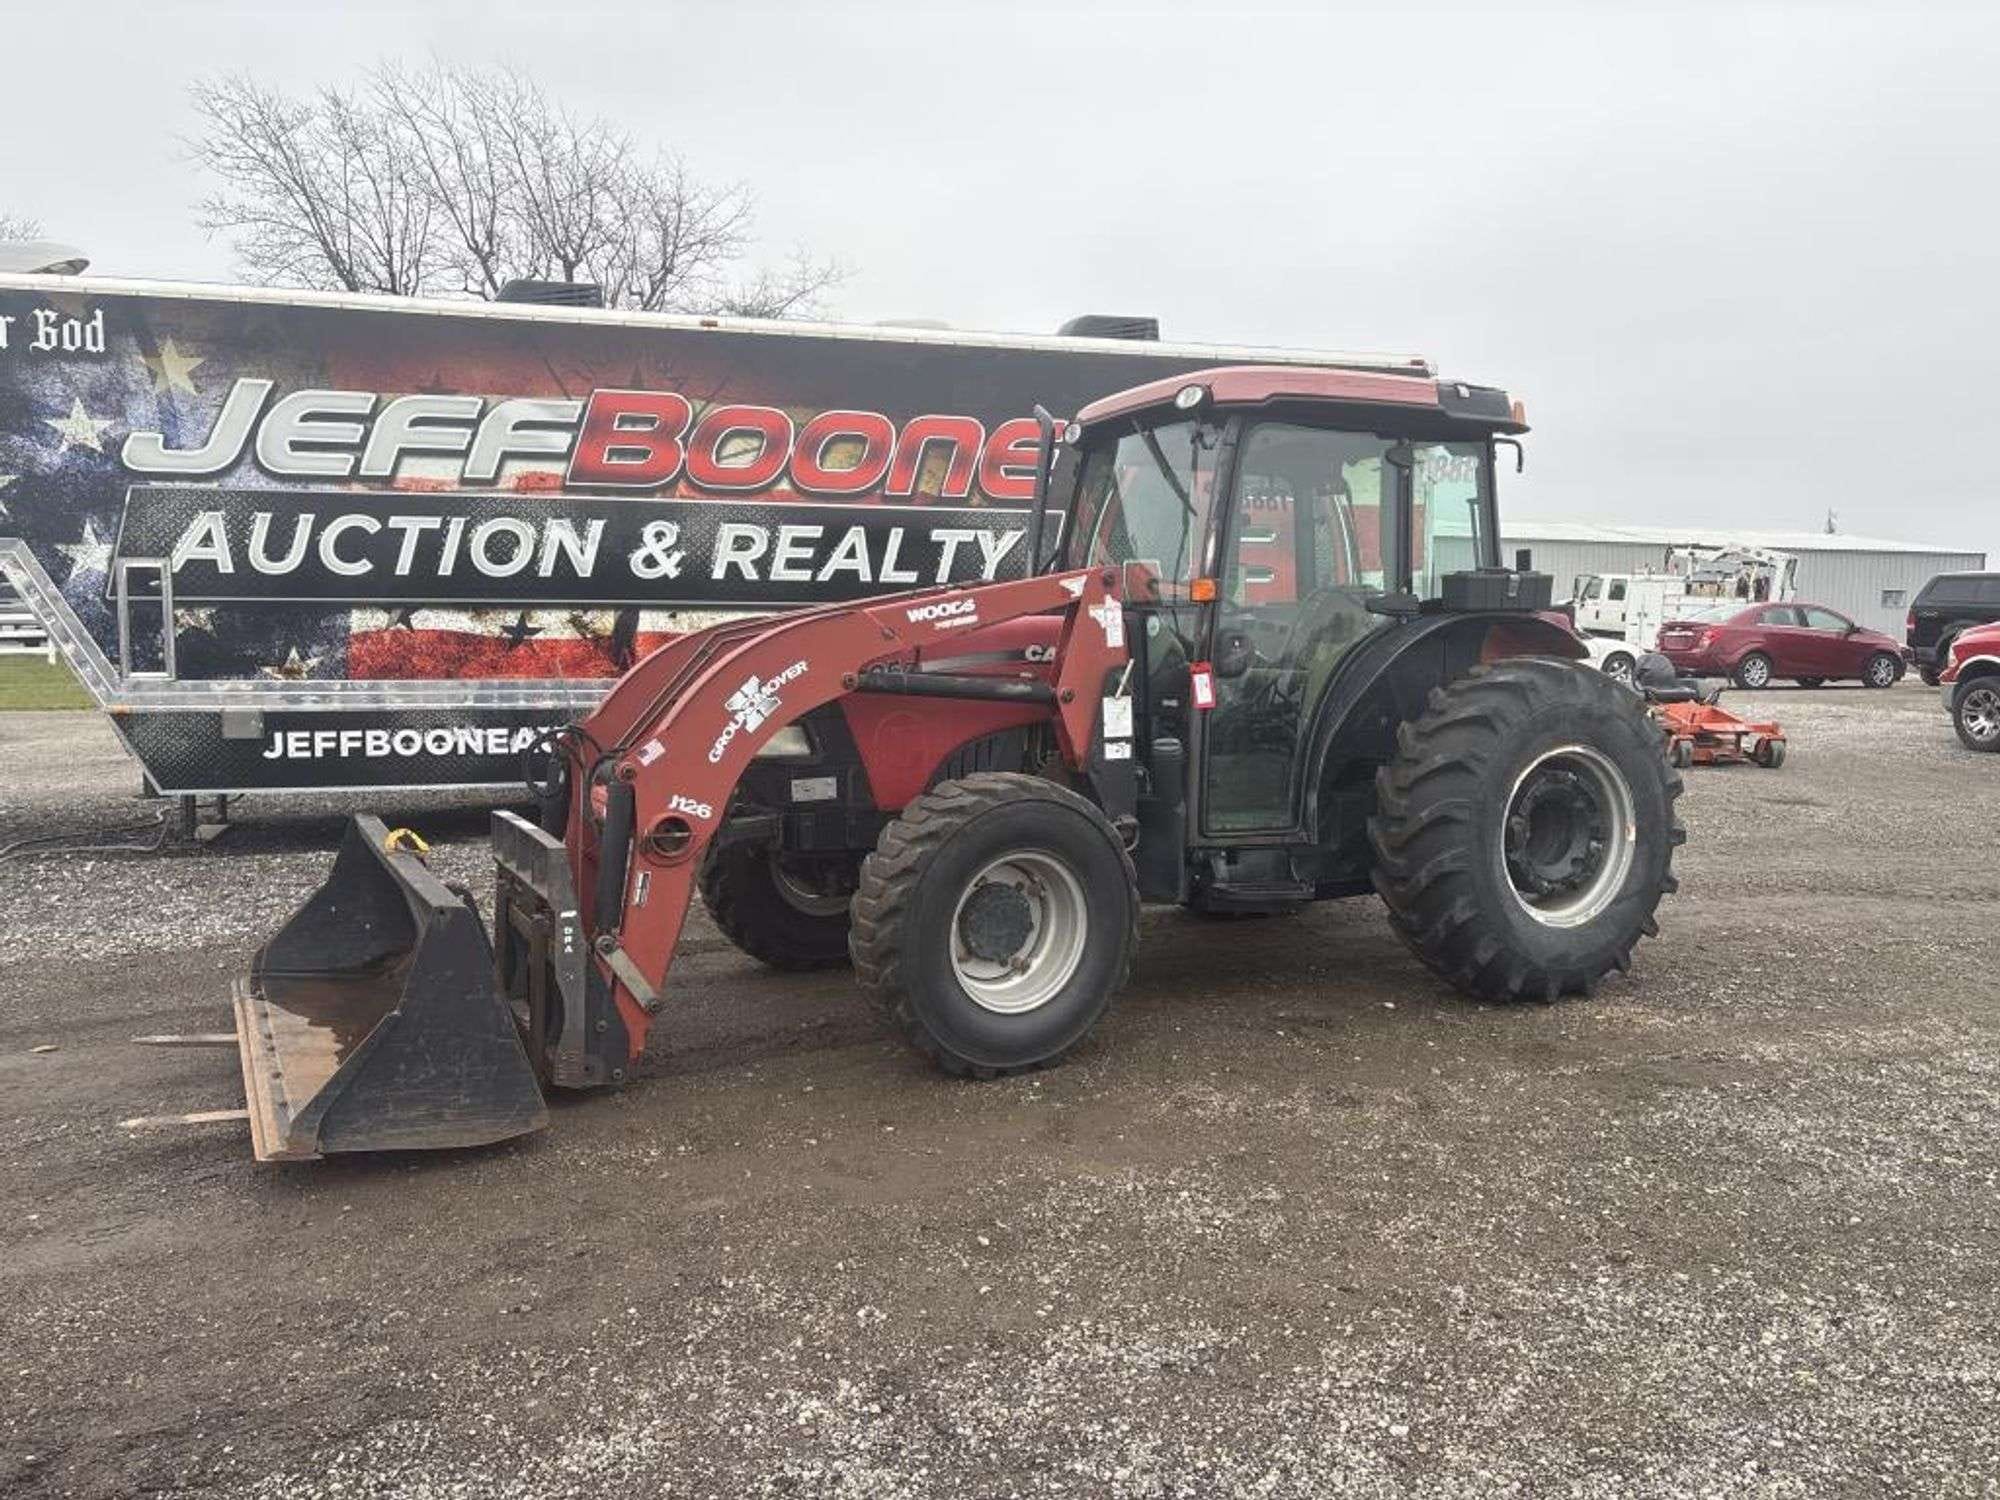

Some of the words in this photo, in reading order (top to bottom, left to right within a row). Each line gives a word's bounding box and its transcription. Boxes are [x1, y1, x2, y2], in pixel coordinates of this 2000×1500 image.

[172, 511, 606, 578] AUCTION
[629, 520, 686, 580] &
[711, 523, 1026, 584] REALTY
[906, 599, 976, 623] WOODS
[668, 795, 712, 819] J126
